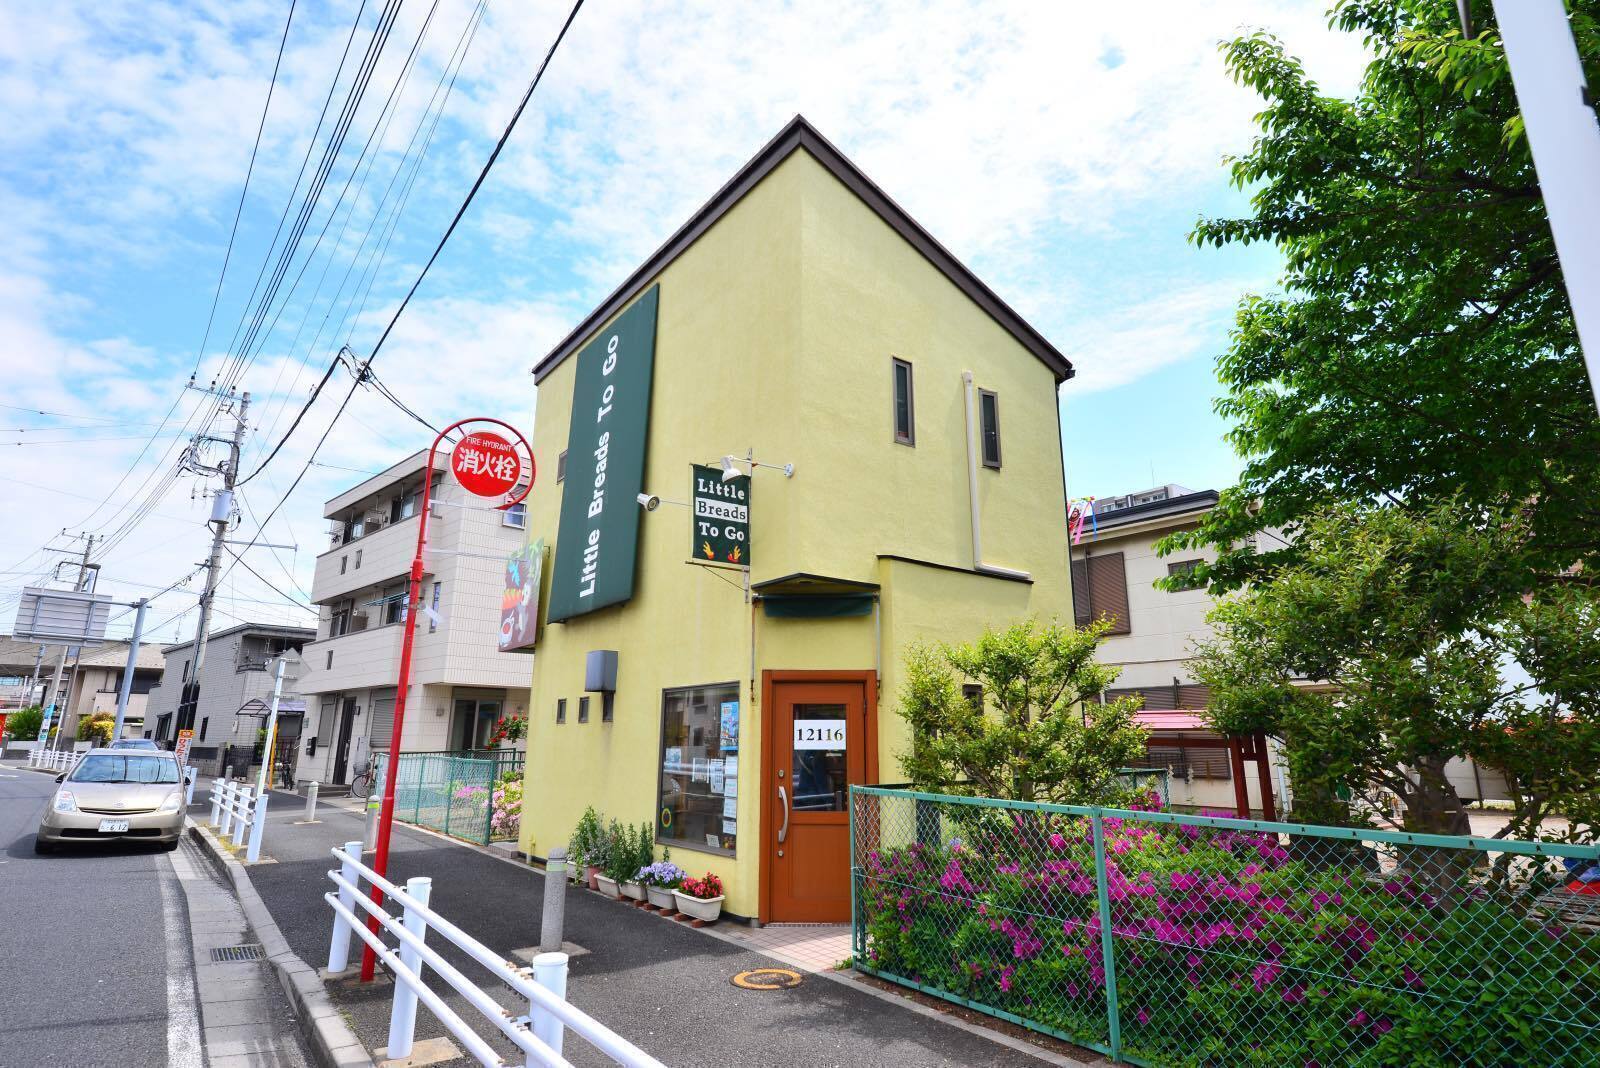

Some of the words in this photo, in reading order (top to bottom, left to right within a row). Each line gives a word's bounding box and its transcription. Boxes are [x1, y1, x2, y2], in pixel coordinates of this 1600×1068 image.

[602, 334, 619, 377] Go
[597, 384, 614, 424] To
[466, 436, 481, 446] FIRE
[482, 439, 512, 452] HYDRANT
[456, 446, 517, 482] 消火栓
[587, 431, 609, 519] Breads
[697, 478, 745, 500] Little
[698, 500, 746, 520] Breads
[698, 521, 719, 537] To
[724, 526, 745, 541] Go
[579, 528, 600, 598] Little
[797, 728, 843, 741] 12116
